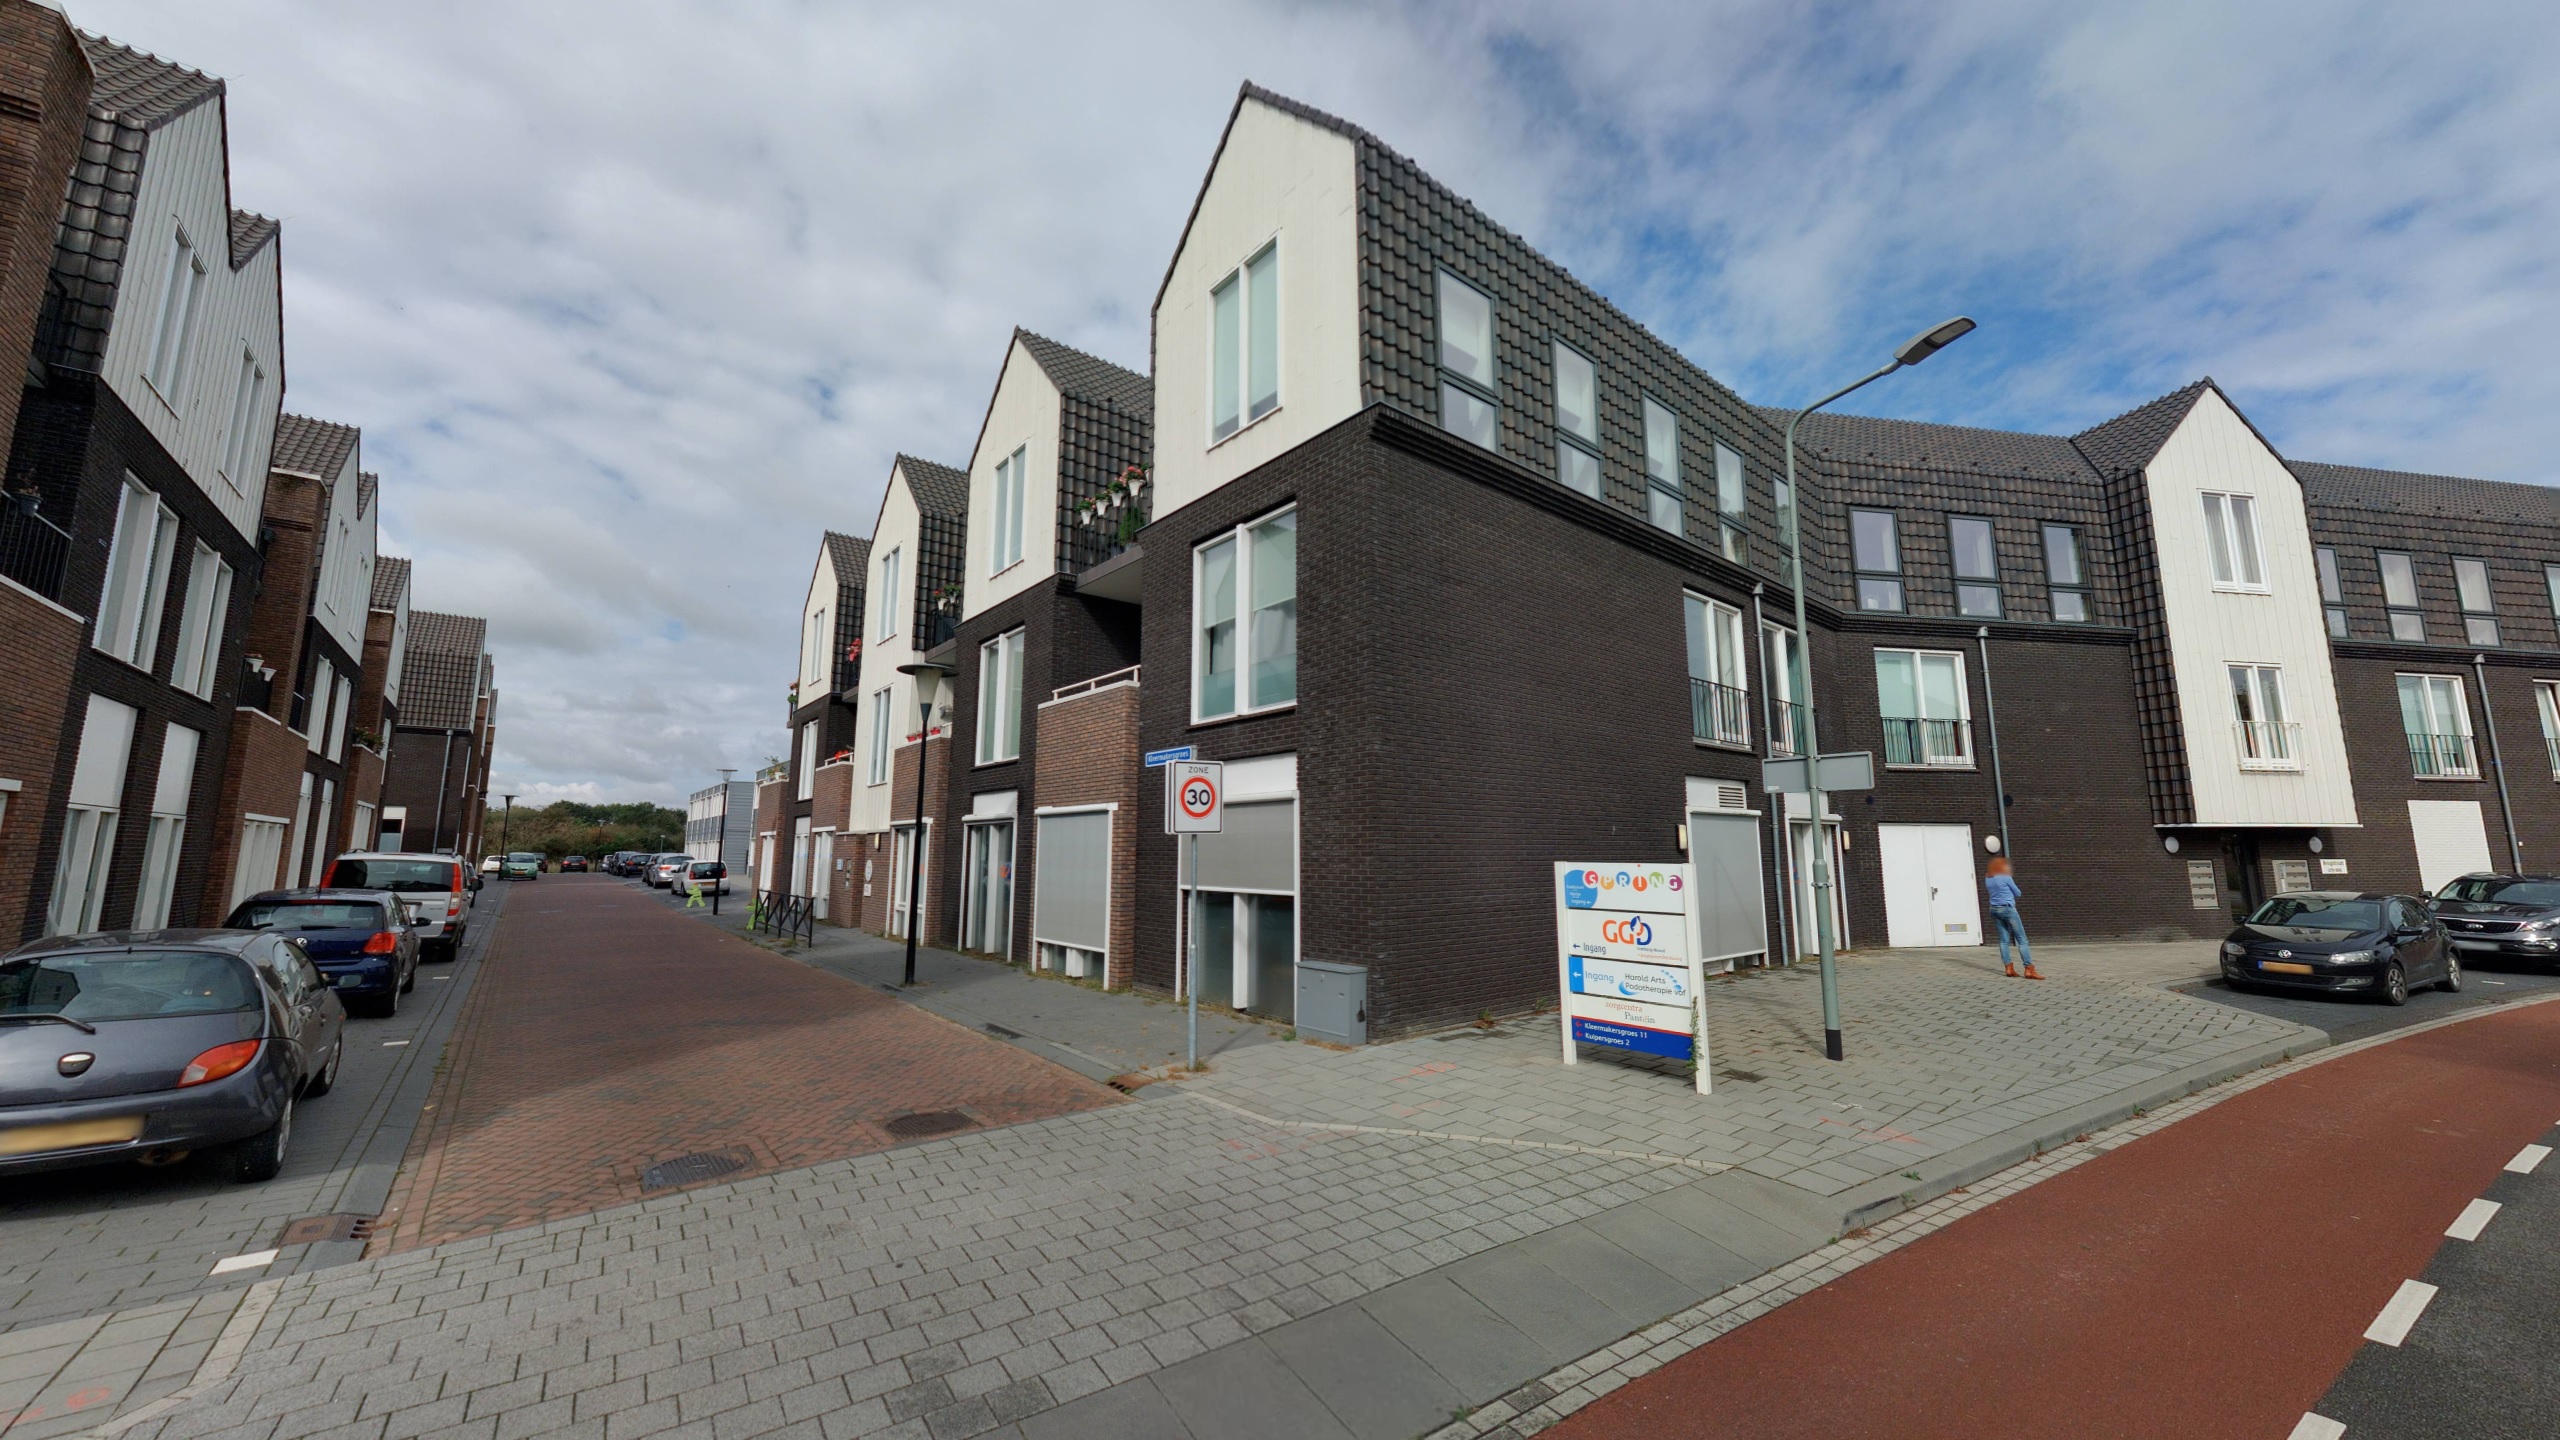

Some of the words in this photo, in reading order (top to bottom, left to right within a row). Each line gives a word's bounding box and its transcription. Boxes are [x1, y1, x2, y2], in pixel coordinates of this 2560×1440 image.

[1148, 751, 1189, 762] Kleermakersgroes
[1186, 789, 1210, 805] 30
[1585, 871, 1683, 891] SPRING
[1602, 916, 1652, 946] GGD
[1583, 943, 1607, 955] Ingang
[1585, 971, 1614, 984] Ingang
[1625, 973, 1648, 982] Harold
[1625, 982, 1672, 995] Podotherapie
[1605, 1001, 1643, 1012] zorgcentra
[1584, 1022, 1638, 1037] Kleermakersgroes
[1585, 1032, 1624, 1045] Kuipersgroes
